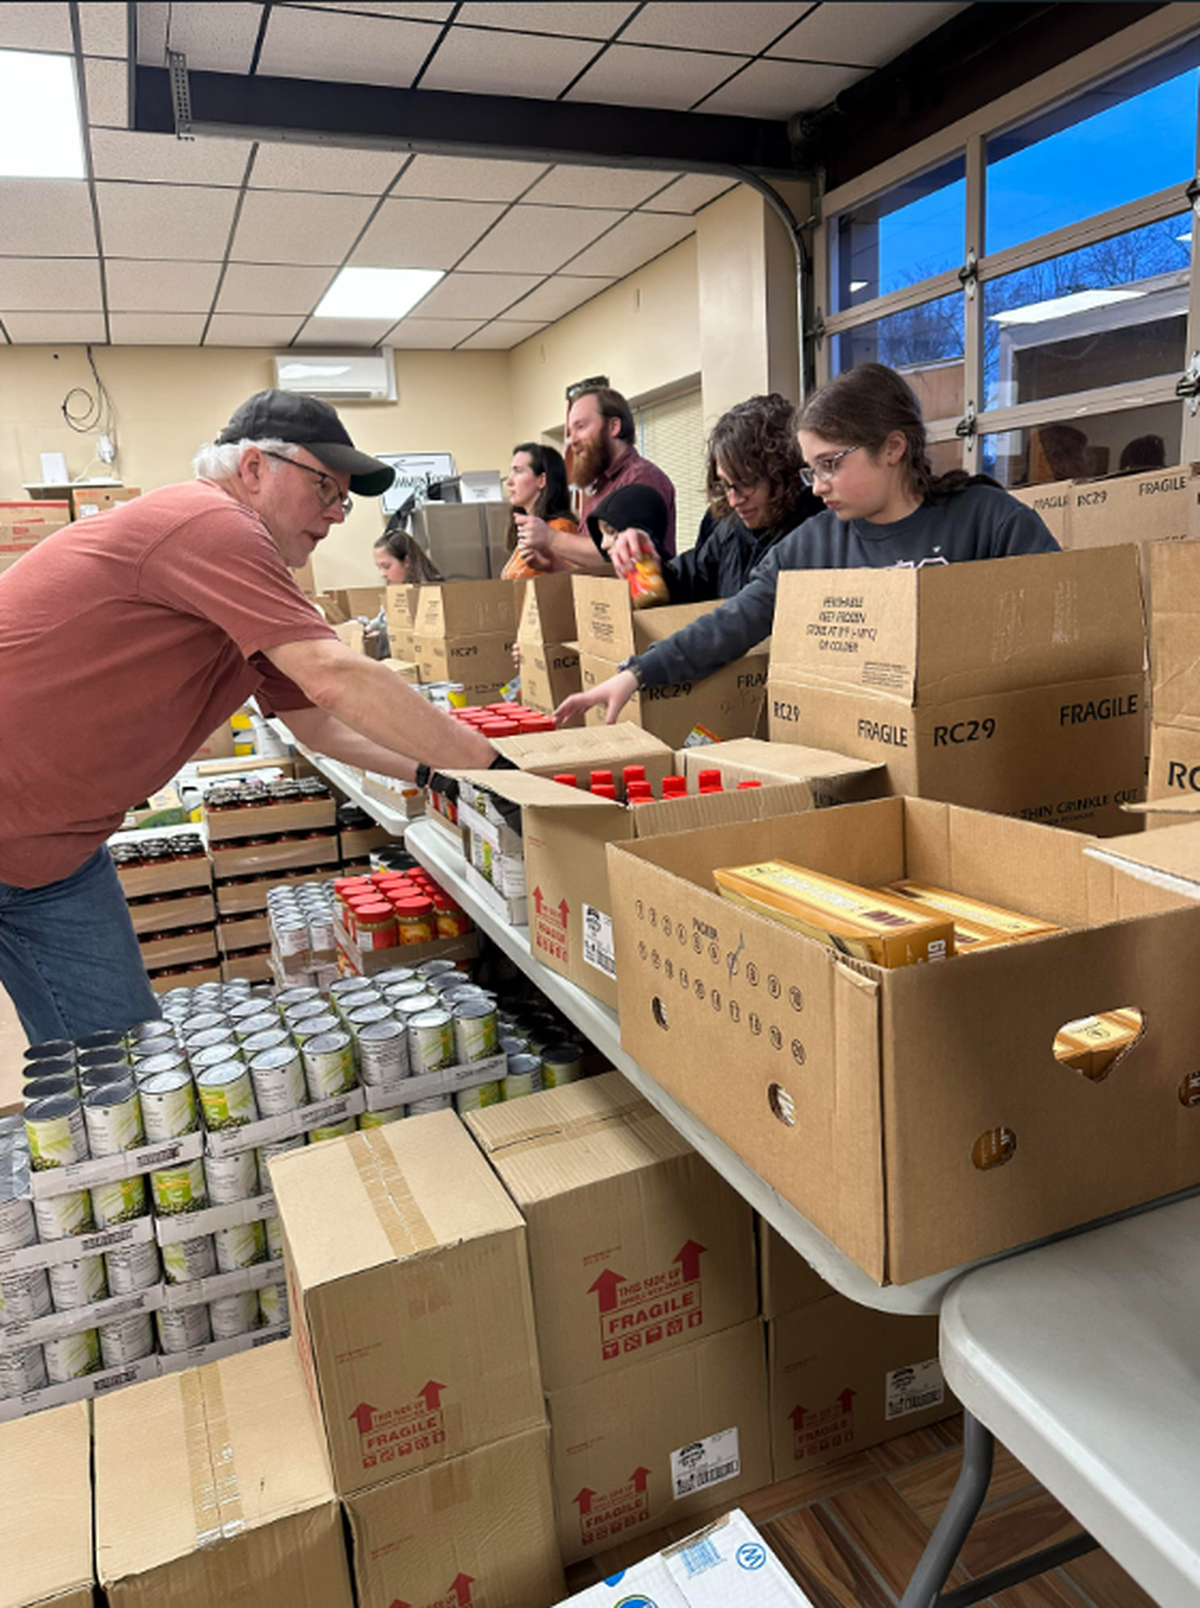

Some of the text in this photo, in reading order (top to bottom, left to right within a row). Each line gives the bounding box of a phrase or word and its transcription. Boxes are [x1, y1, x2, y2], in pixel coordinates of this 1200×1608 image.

[1076, 490, 1107, 508] RC29
[1138, 476, 1187, 496] FRAGILE
[553, 653, 580, 670] RC2
[649, 682, 693, 701] RC29
[773, 701, 800, 722] RC29
[1060, 694, 1139, 727] FRAGILE
[857, 719, 908, 748] FRAGILE
[933, 717, 996, 747] RC29
[1056, 794, 1110, 814] CRINKLE
[1113, 788, 1139, 804] CUT
[619, 1281, 642, 1298] THIS
[608, 1290, 694, 1335] FRAGILE
[366, 1416, 438, 1450] FRAGILE
[585, 1498, 643, 1529] FRAGILE
